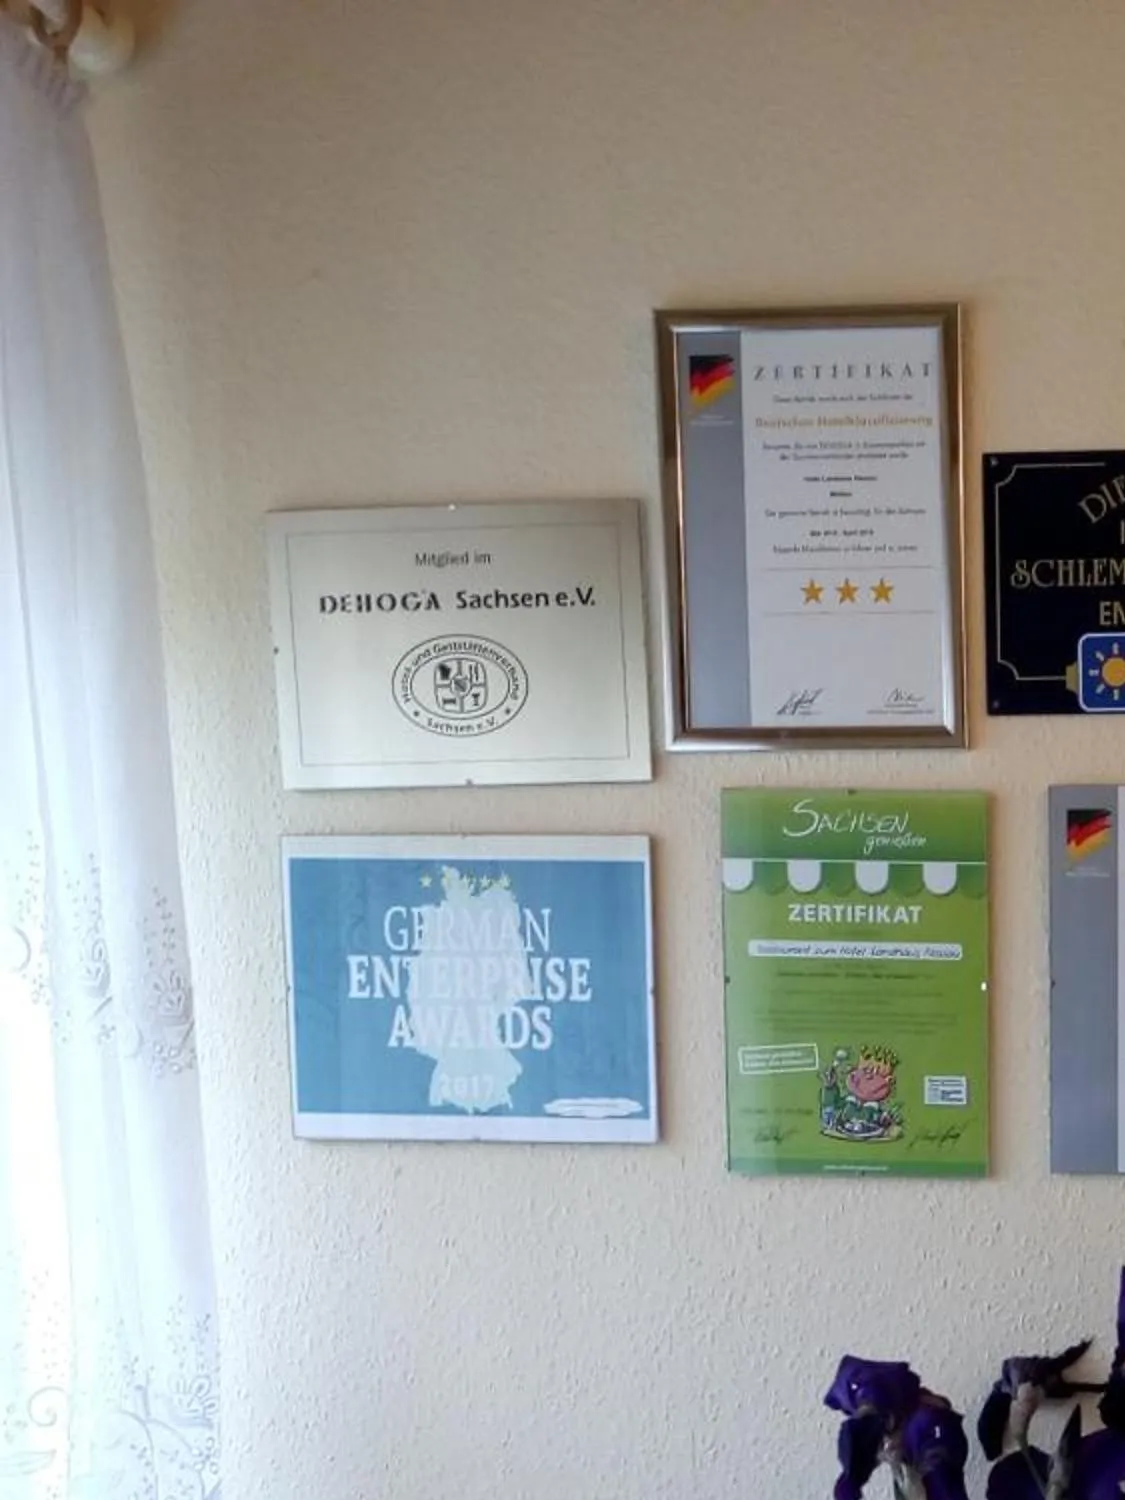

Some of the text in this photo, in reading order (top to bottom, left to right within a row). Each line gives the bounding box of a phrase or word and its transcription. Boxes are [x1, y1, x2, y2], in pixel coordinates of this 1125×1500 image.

[415, 551, 491, 568] Mitglied im
[319, 587, 596, 614] DEHOGA Sachsen e.V.
[384, 905, 552, 952] GERMAN
[788, 903, 923, 923] ZERTIFIKAT
[346, 954, 592, 1001] ENTERPRISE
[387, 1005, 553, 1050] AWARDS
